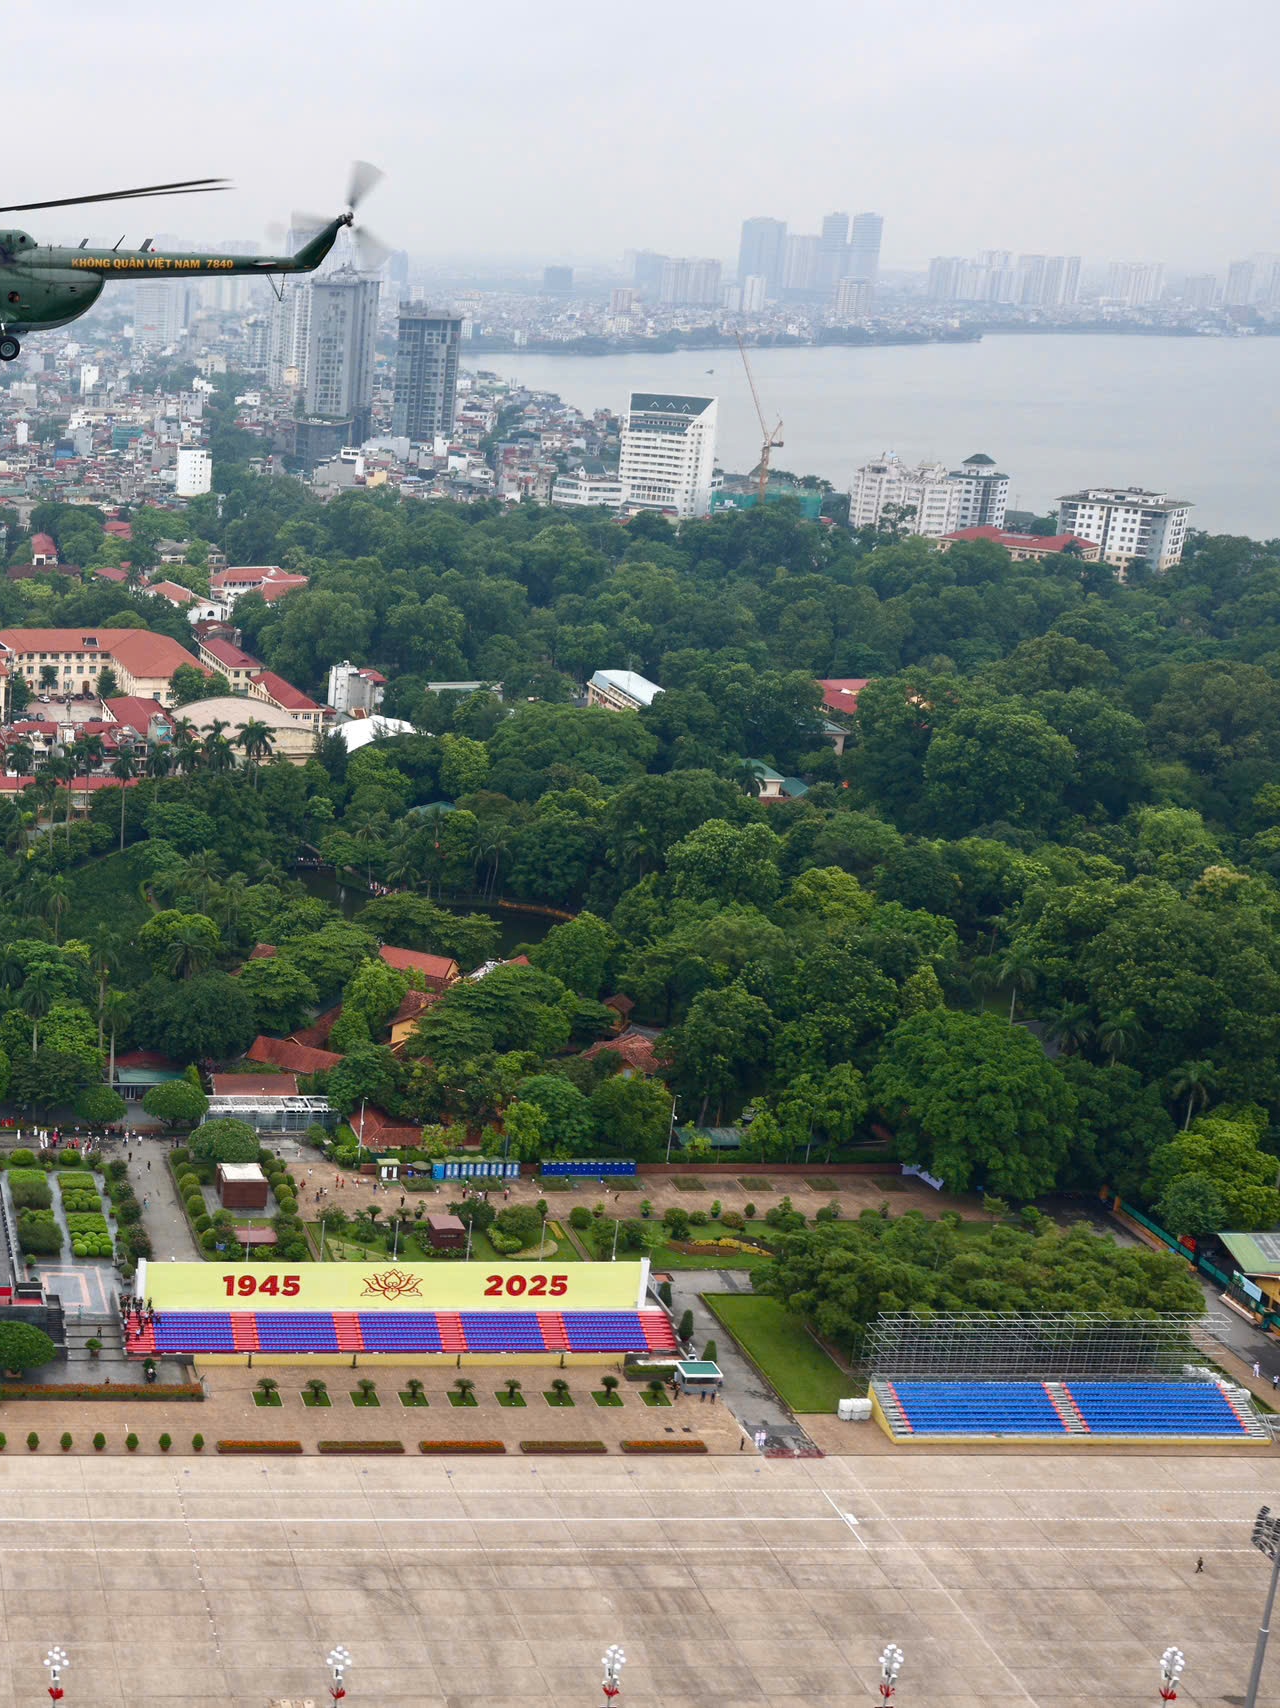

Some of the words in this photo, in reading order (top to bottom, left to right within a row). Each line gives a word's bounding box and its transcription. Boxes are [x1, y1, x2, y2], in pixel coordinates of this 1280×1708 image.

[72, 256, 110, 269] KHÔNG
[113, 256, 145, 270] QUÂN
[146, 256, 172, 270] VIỆT
[174, 258, 200, 269] NAM
[207, 258, 234, 269] 7840
[223, 1275, 301, 1297] 1945
[484, 1275, 569, 1297] 2025
